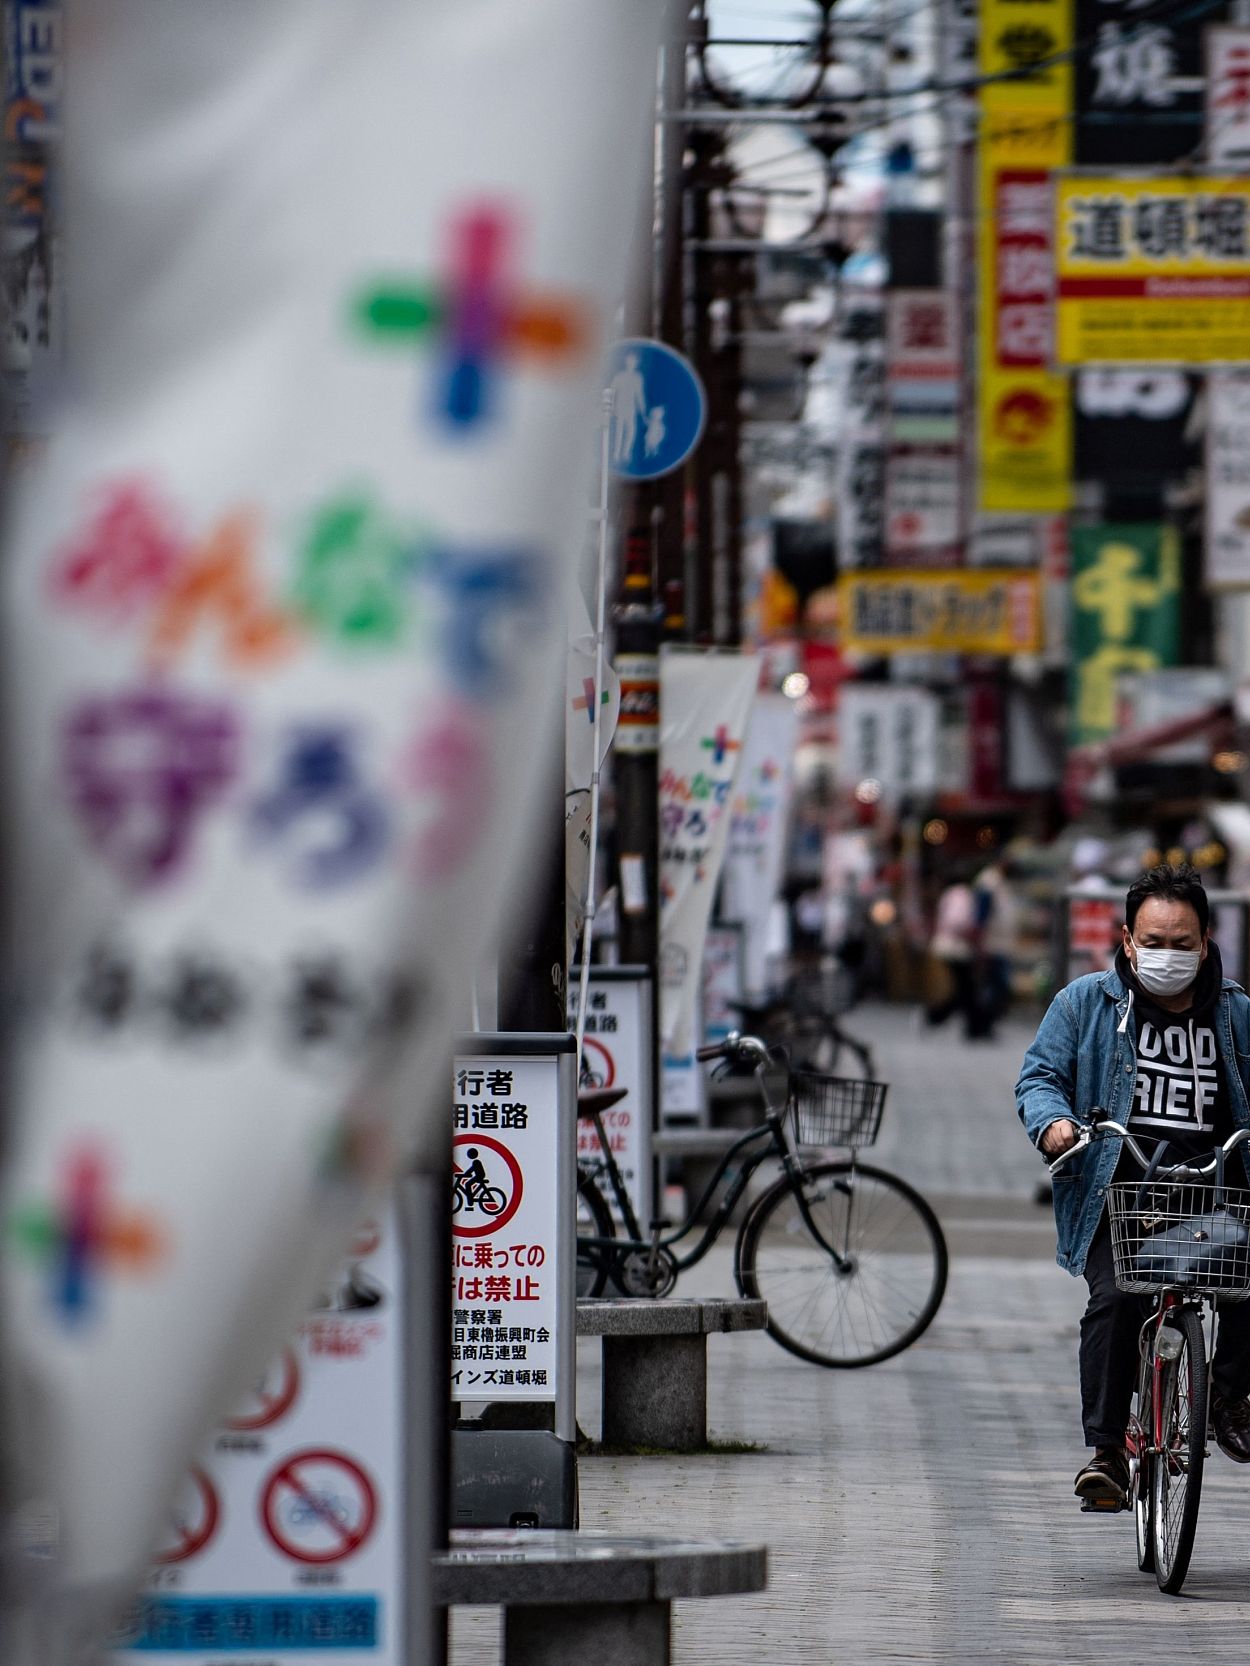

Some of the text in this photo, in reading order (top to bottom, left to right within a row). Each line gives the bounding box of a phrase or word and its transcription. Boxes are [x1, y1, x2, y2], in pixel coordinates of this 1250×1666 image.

[453, 1069, 513, 1096] 行者
[451, 1275, 540, 1302] は禁止
[453, 1309, 503, 1326] 警察署
[451, 1369, 548, 1386] インズ道頓堀
